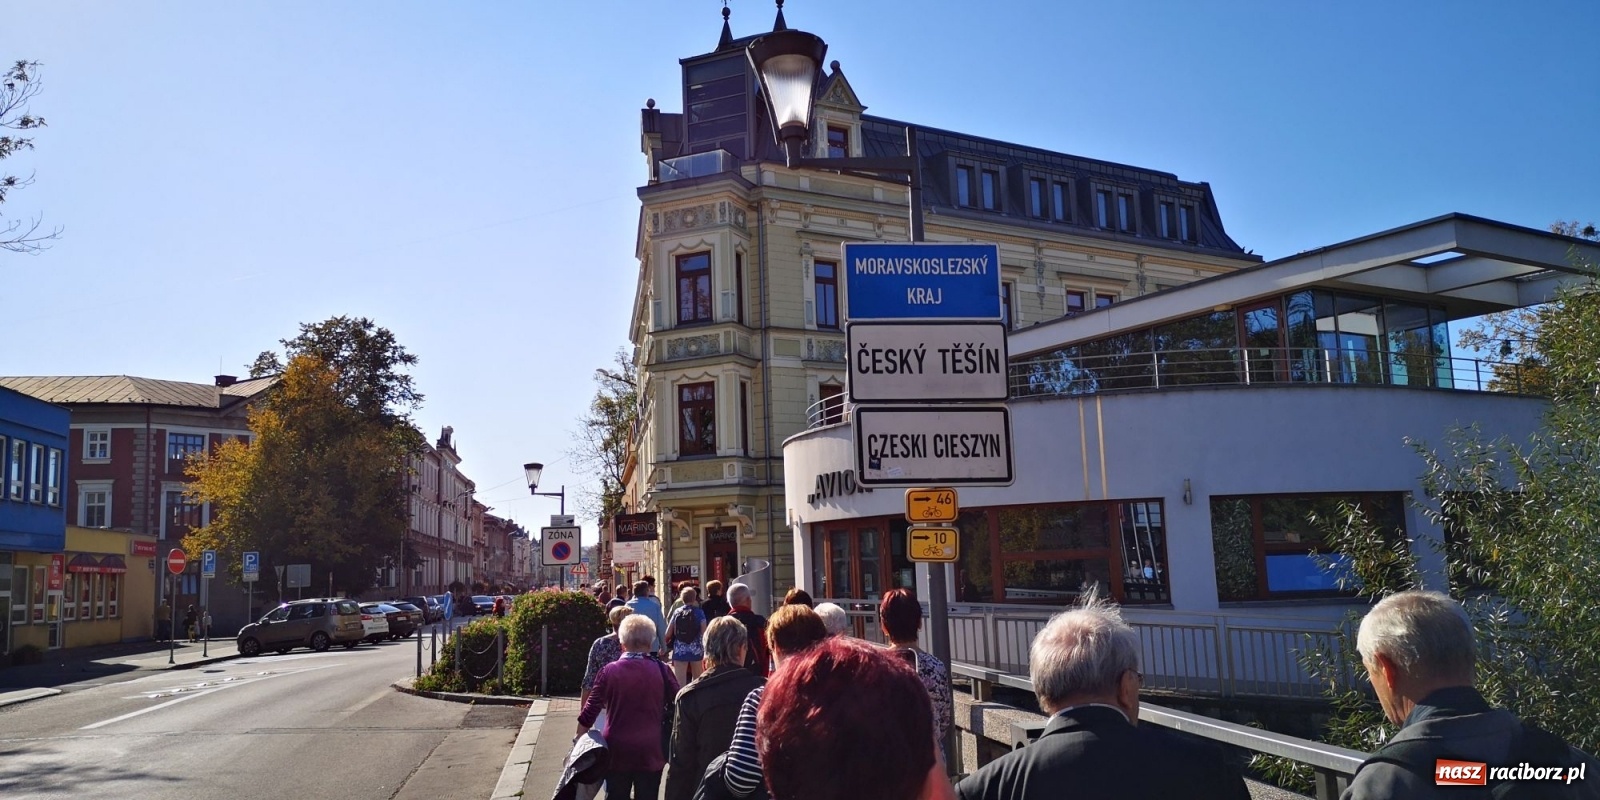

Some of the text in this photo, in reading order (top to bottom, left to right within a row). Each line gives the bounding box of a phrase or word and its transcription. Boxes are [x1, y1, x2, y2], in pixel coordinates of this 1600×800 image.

[855, 254, 989, 275] MORAVSKOSLEZSKÝ
[907, 287, 942, 305] KRAJ
[857, 342, 1000, 375] ČESKÝ TĚŠÍN
[867, 433, 1001, 459] CZESKI CIESZYN
[936, 493, 952, 506] 46
[618, 522, 656, 532] MARINO
[548, 529, 574, 540] ZÓNA
[710, 531, 736, 539] MARINO
[933, 532, 947, 545] 10
[205, 553, 213, 566] P
[246, 554, 255, 566] P
[672, 566, 691, 574] BUTY
